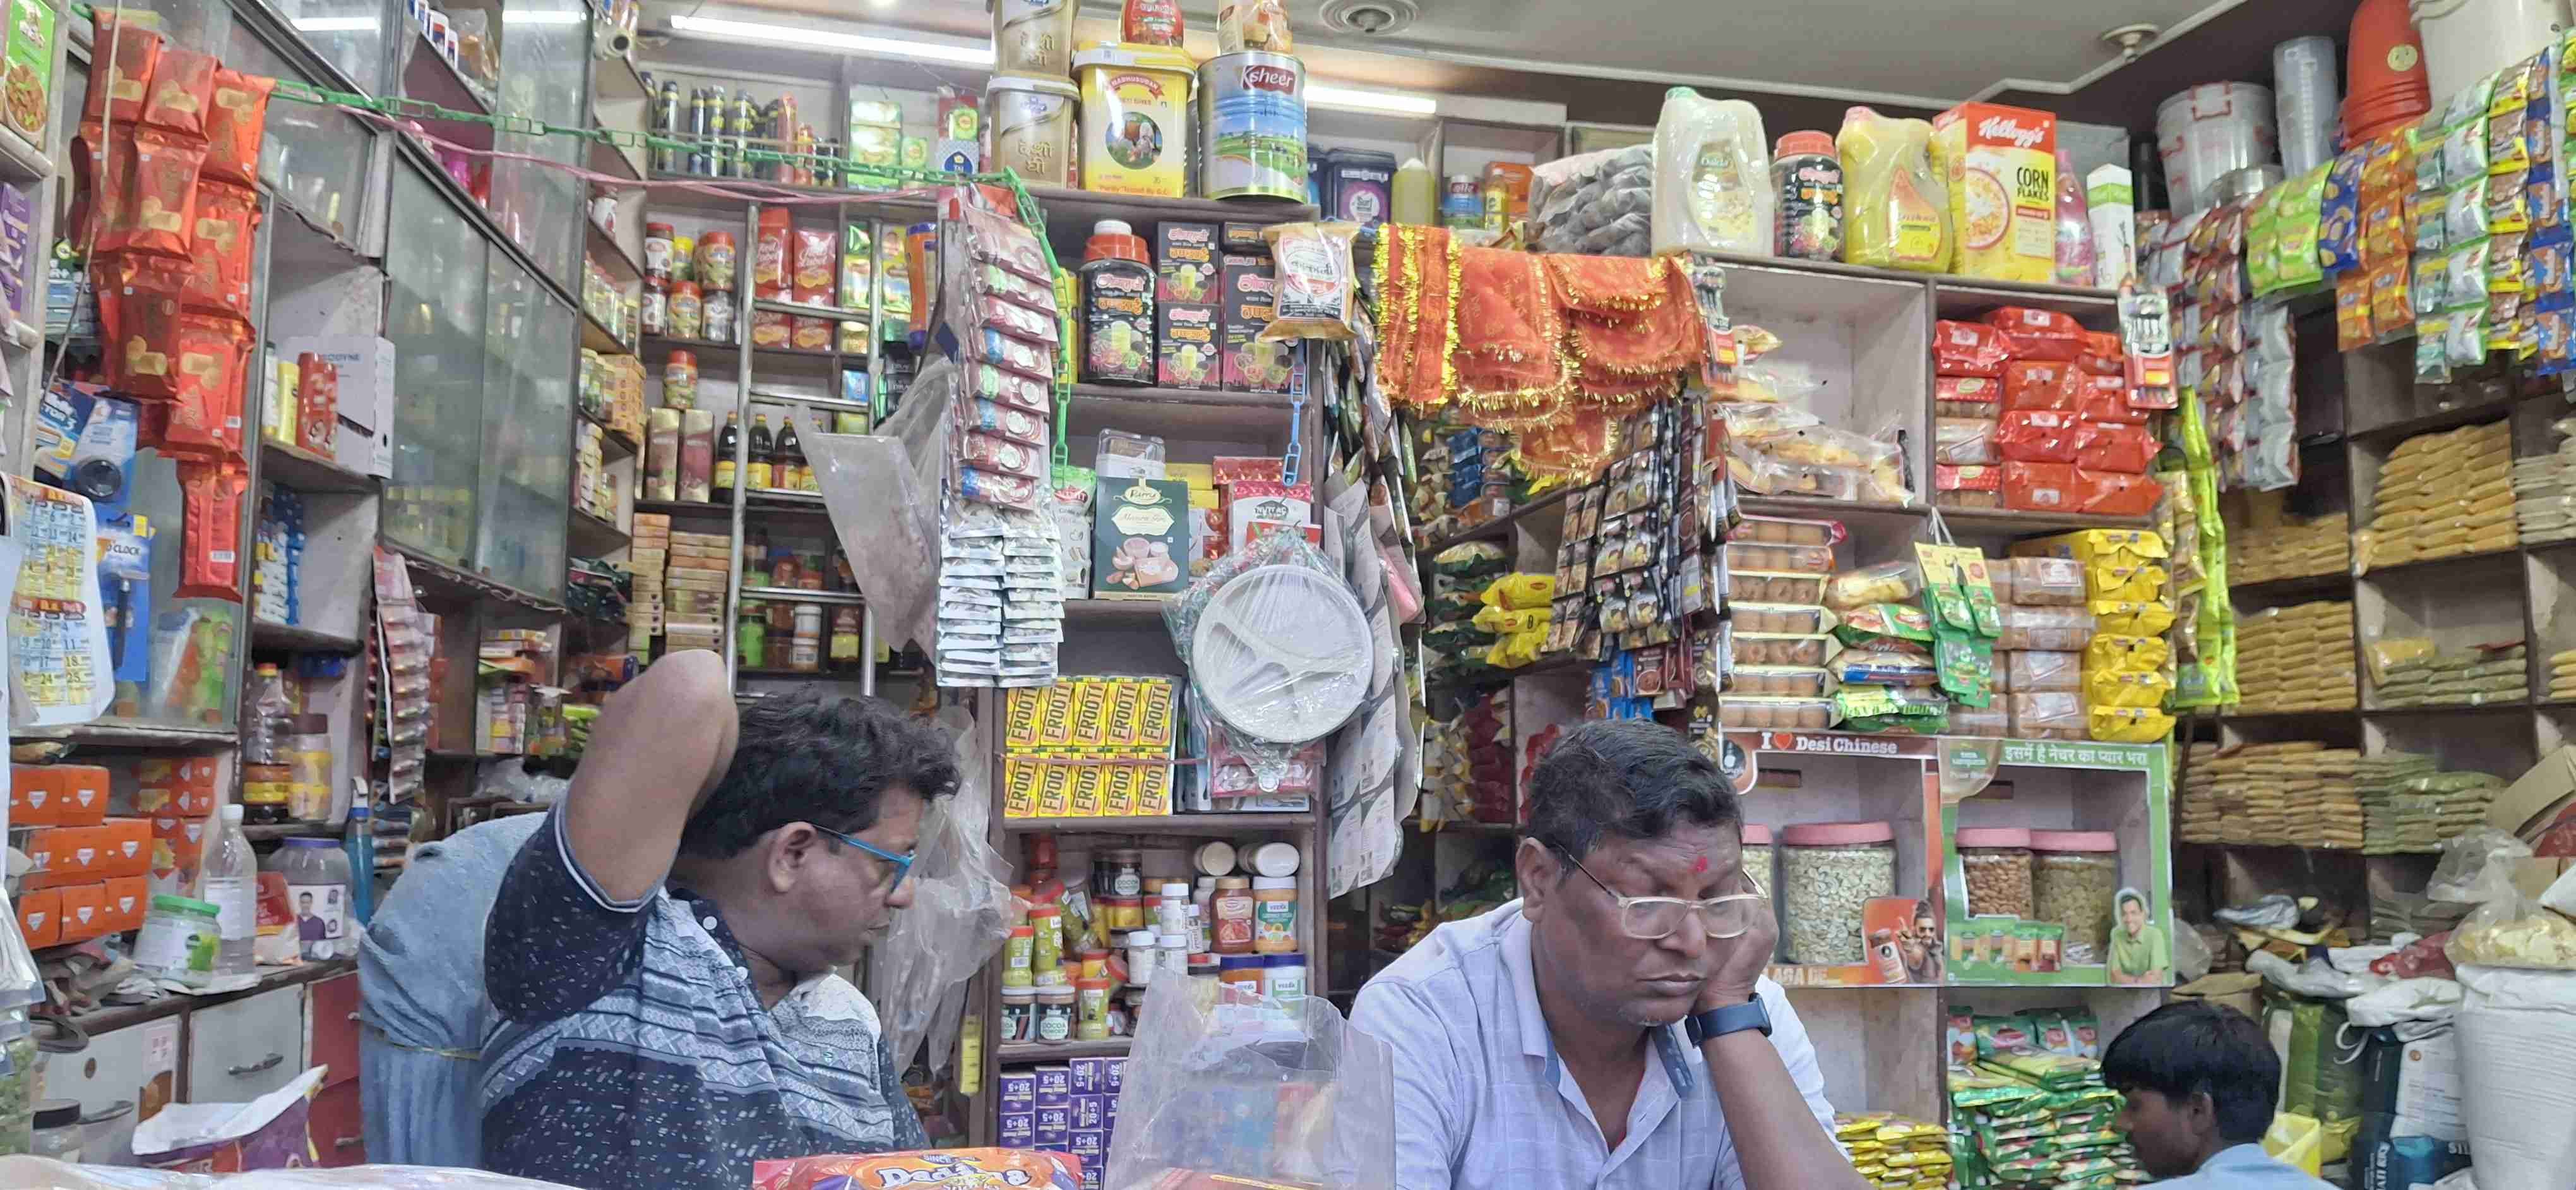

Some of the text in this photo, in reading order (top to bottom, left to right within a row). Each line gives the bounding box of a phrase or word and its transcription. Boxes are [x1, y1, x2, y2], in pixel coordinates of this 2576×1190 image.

[1241, 66, 1293, 88] Ksheer
[1978, 116, 2045, 148] Kellogg's
[2017, 167, 2049, 192] CORN
[2017, 188, 2049, 201] FLAKES
[1761, 732, 1898, 754] I Desi Chinese
[2037, 744, 2046, 762] है
[2077, 749, 2096, 762] का
